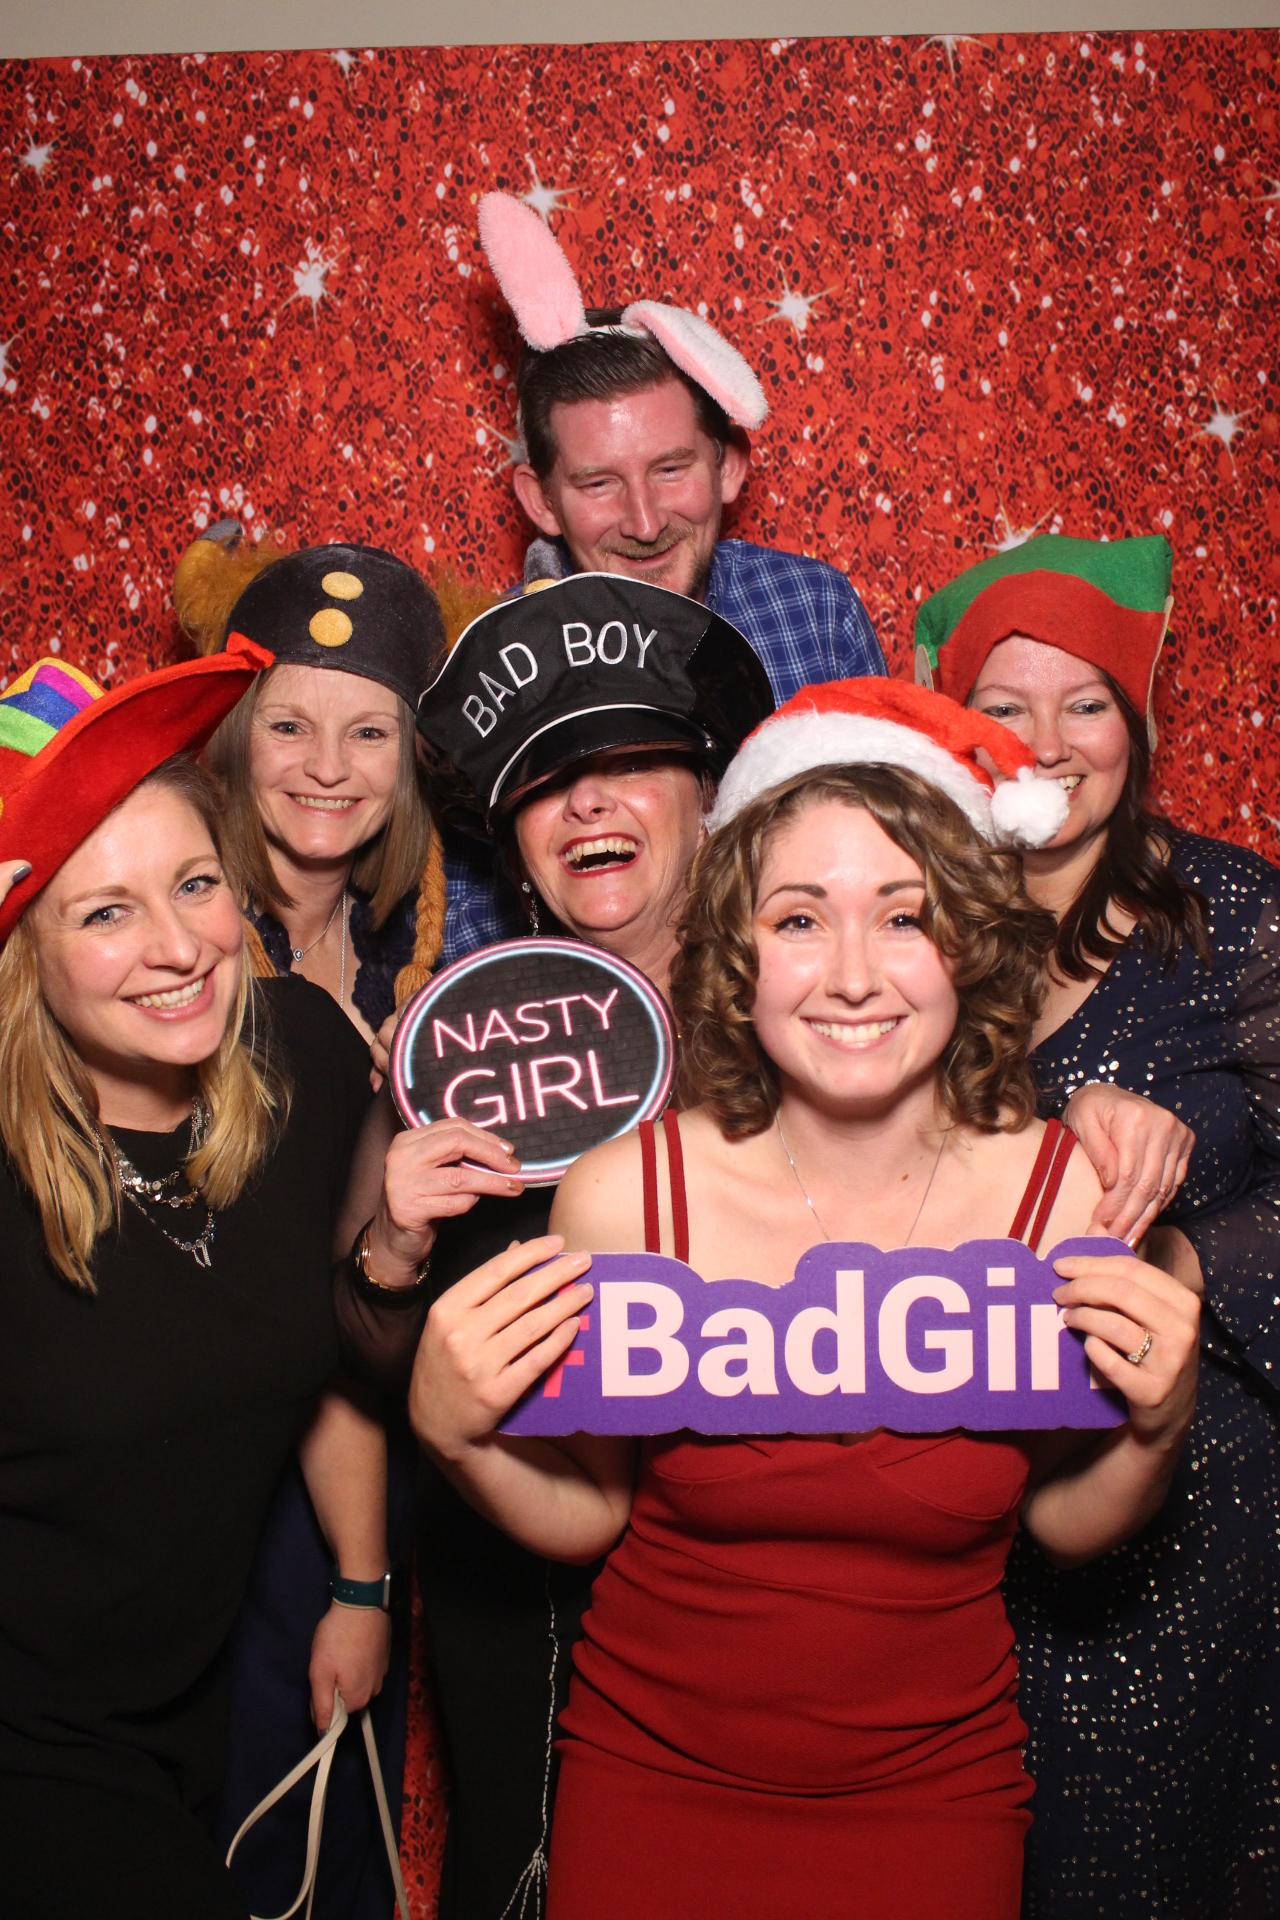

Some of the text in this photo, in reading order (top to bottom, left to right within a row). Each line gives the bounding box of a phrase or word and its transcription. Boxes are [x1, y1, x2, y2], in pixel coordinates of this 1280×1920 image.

[461, 621, 658, 738] BAD BOY
[432, 988, 619, 1058] NASTY
[443, 1049, 640, 1128] GIRL
[543, 1267, 1110, 1397] BadGir
